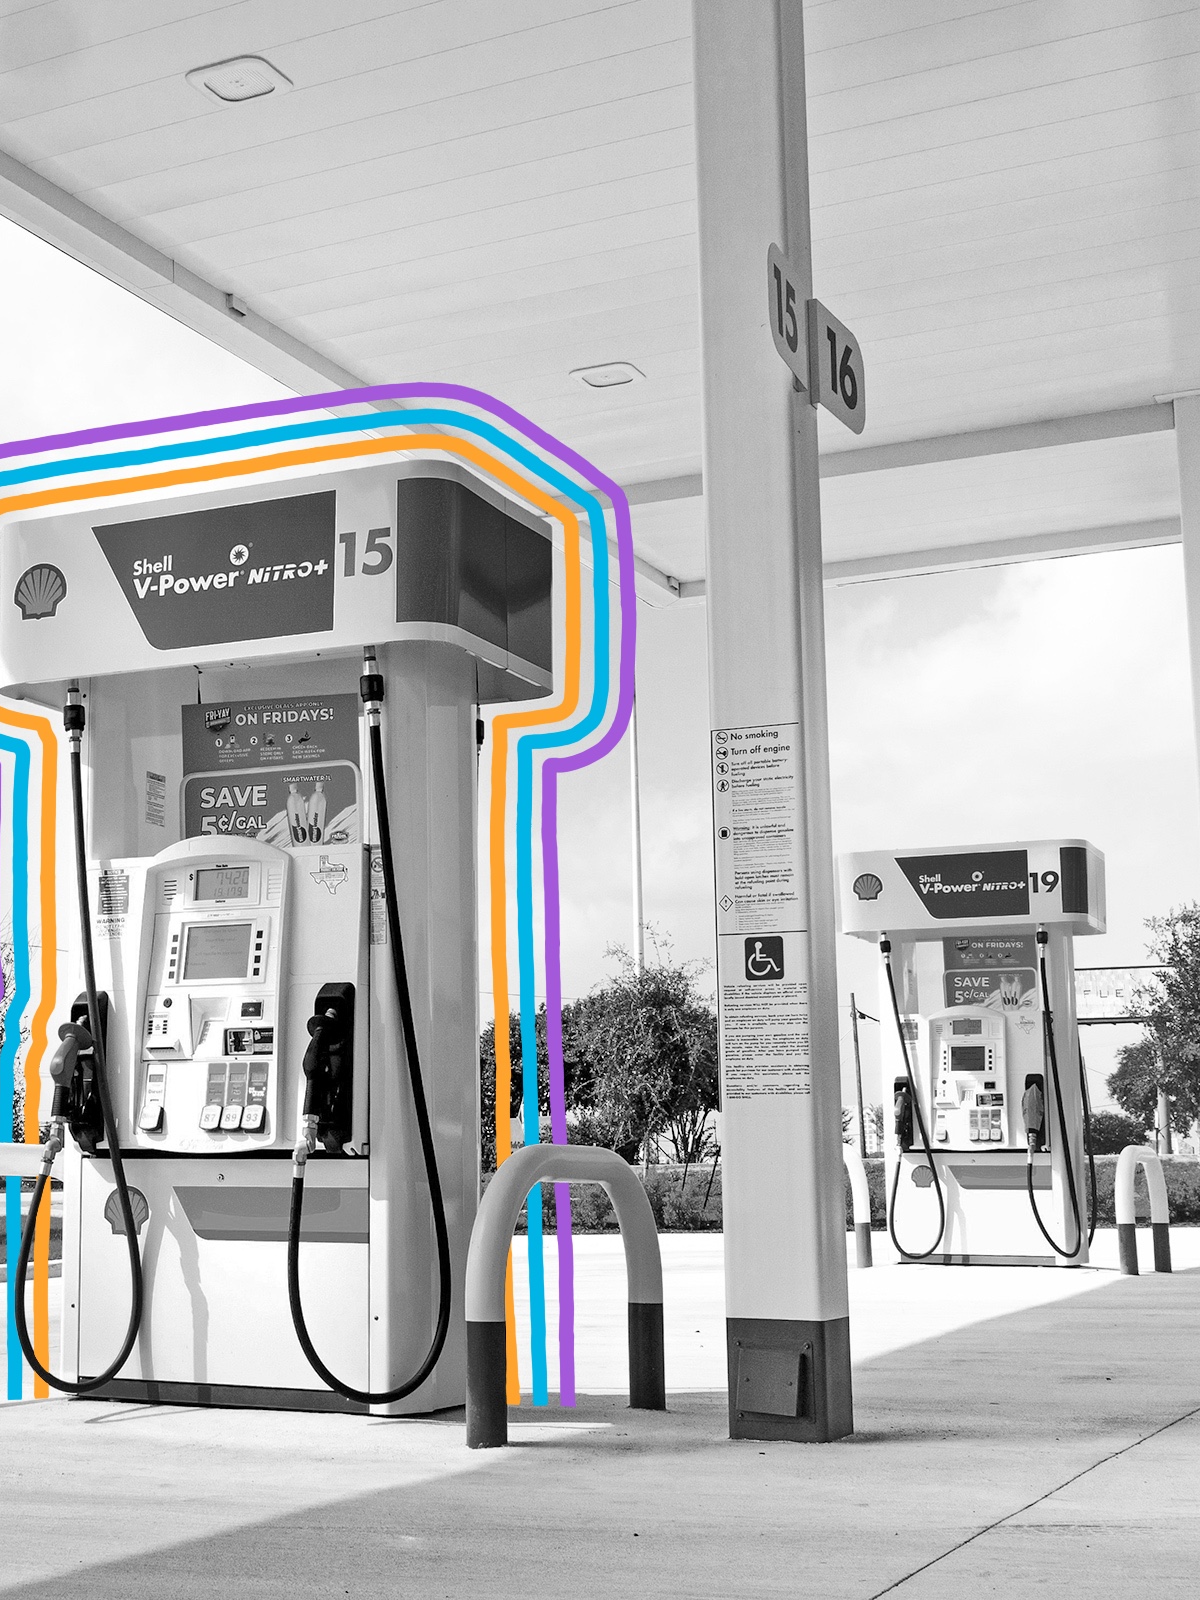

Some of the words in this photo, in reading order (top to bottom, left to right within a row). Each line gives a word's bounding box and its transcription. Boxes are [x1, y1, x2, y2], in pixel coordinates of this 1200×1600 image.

[773, 262, 798, 353] 15
[826, 325, 858, 410] 16
[339, 527, 393, 577] 15
[133, 554, 173, 576] Shell
[133, 570, 240, 598] V-Power
[235, 713, 258, 726] ON
[263, 708, 334, 724] FRIDAYS!
[730, 733, 743, 741] No
[745, 730, 779, 739] smoking
[750, 745, 761, 754] off
[763, 744, 790, 754] engine
[200, 784, 267, 809] SAVE
[189, 873, 194, 881] $
[919, 873, 941, 883] Shell
[1029, 870, 1059, 893] 19
[919, 883, 978, 894] V-Power
[954, 977, 990, 987] SAVE
[224, 1113, 237, 1122] 89
[245, 1113, 258, 1122] 93
